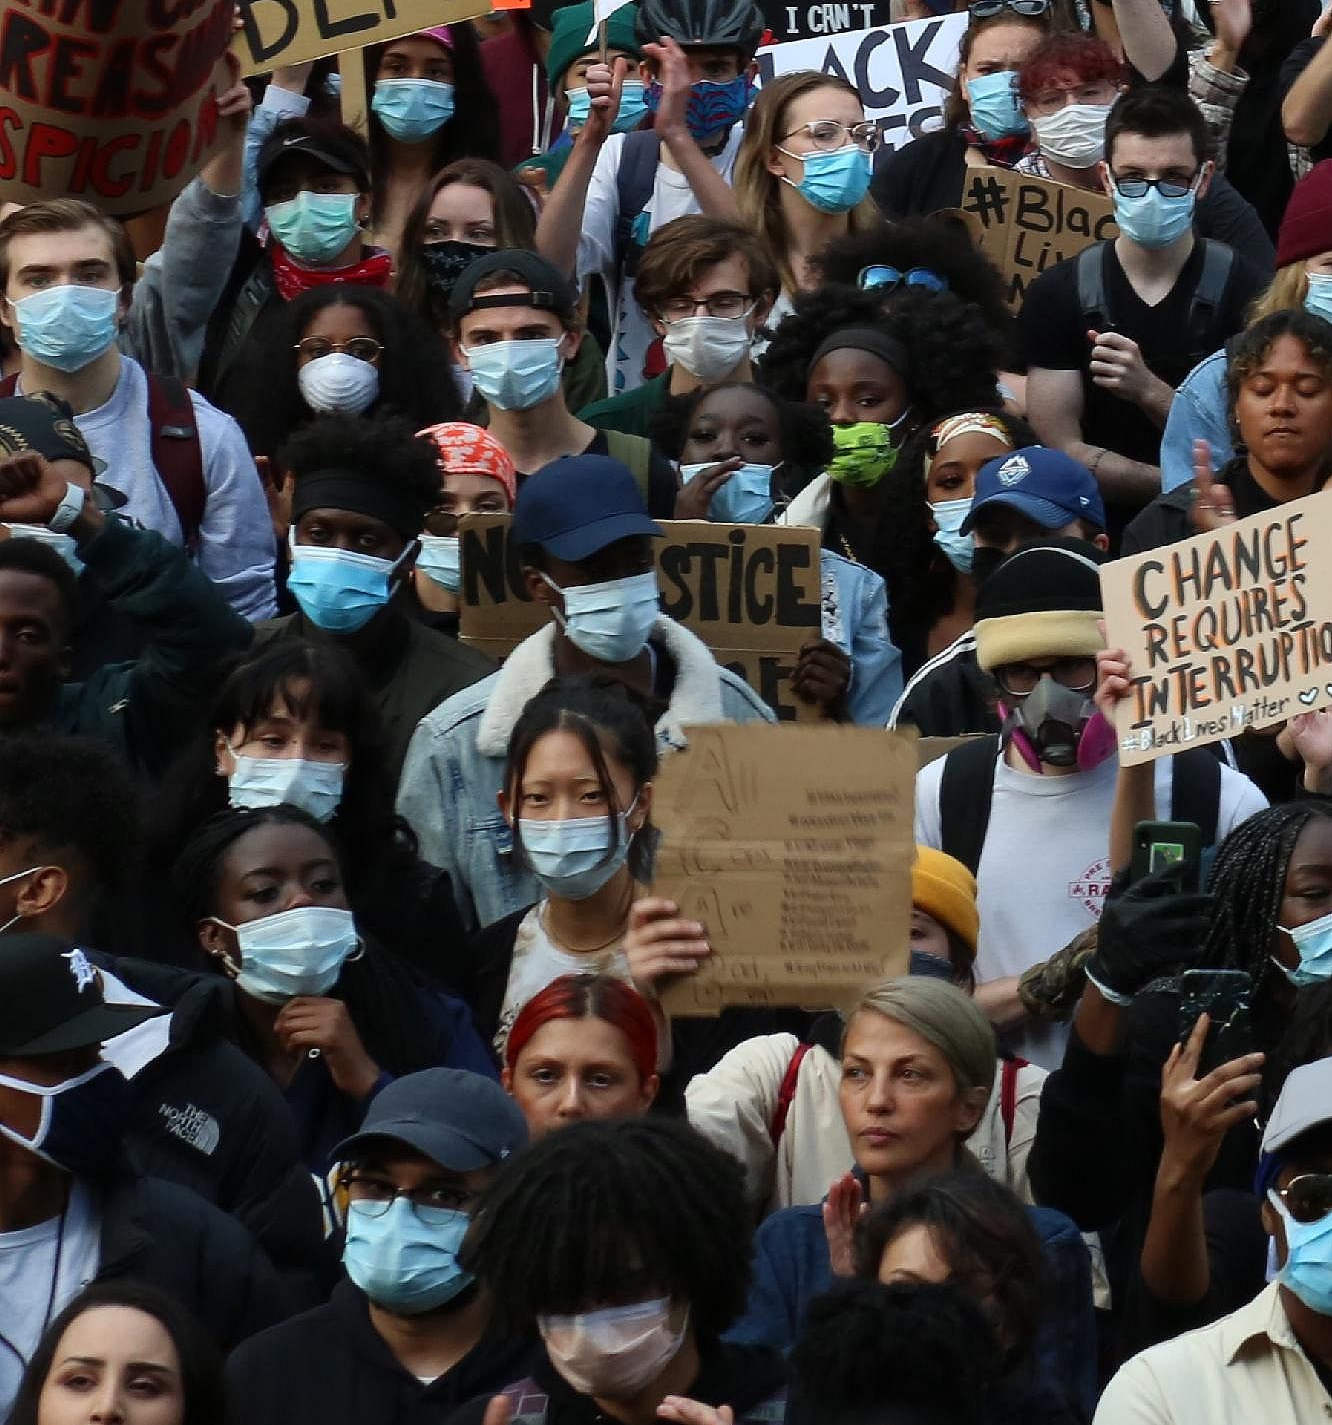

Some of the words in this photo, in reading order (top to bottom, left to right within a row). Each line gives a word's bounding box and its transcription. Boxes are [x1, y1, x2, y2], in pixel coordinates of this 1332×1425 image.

[787, 6, 799, 34] I
[807, 2, 877, 32] CAN'T
[1132, 511, 1309, 621] CHANGE
[1144, 573, 1309, 668] REQUIRES
